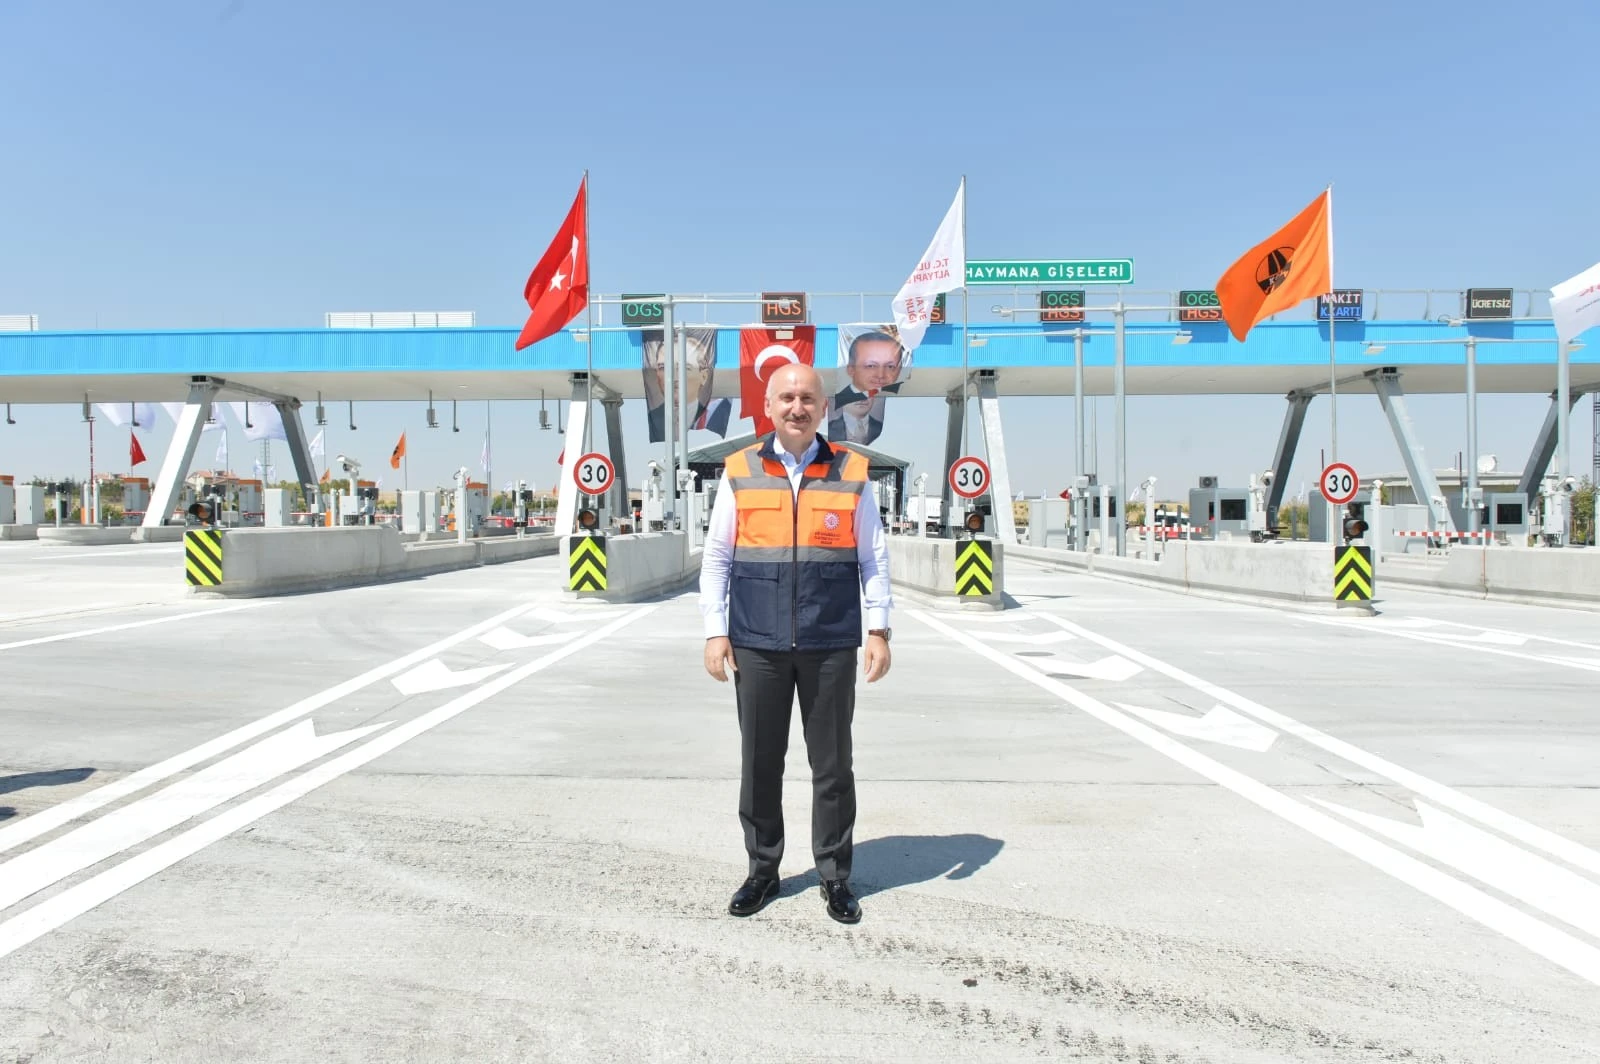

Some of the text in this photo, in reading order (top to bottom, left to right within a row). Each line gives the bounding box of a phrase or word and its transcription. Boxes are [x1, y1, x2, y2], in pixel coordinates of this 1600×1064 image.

[966, 263, 1124, 280] HAYMANA GİŞELERİ
[1047, 293, 1080, 306] OGS
[1186, 293, 1220, 306] OGS
[1322, 291, 1360, 304] NAKİT
[1472, 298, 1511, 309] ÜCRETSİZ
[626, 302, 663, 317] OGS
[767, 300, 802, 316] HGS
[1048, 306, 1080, 319] HGS
[1187, 307, 1220, 319] HGS
[582, 464, 607, 483] 30
[958, 468, 983, 487] 30
[1328, 474, 1352, 493] 30
